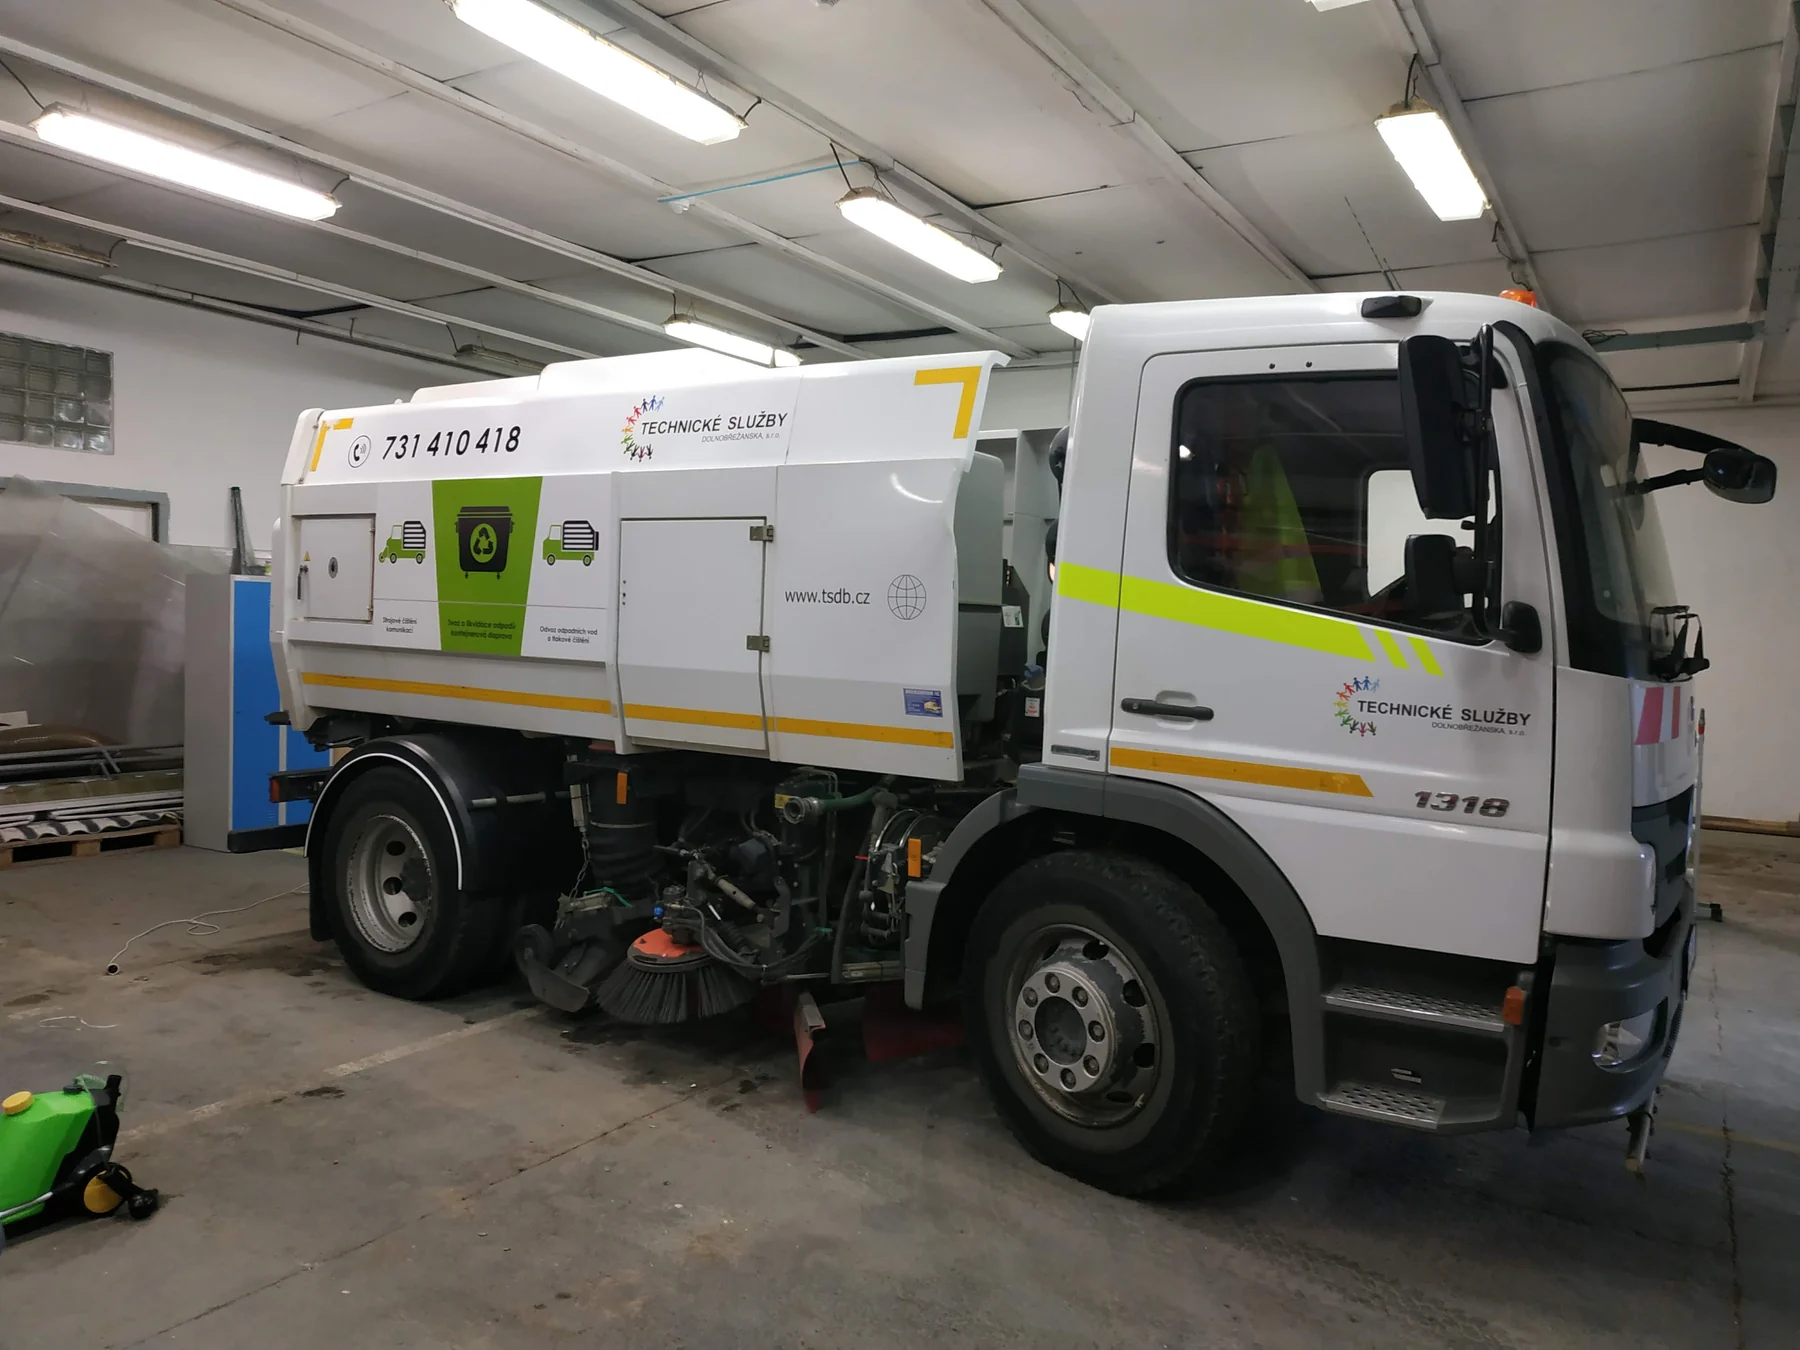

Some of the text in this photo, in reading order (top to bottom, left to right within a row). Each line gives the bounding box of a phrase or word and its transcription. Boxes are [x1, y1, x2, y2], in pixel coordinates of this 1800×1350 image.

[641, 411, 788, 435] TECHNICKÉ SLUŽBY
[382, 425, 521, 460] 731 410 418
[784, 588, 870, 604] www.tsdb.cz
[487, 631, 513, 640] doprava
[540, 625, 557, 633] Odvoz
[1357, 700, 1531, 726] TECHNICKÉ SLUŽBY
[1414, 791, 1510, 818] 1318
